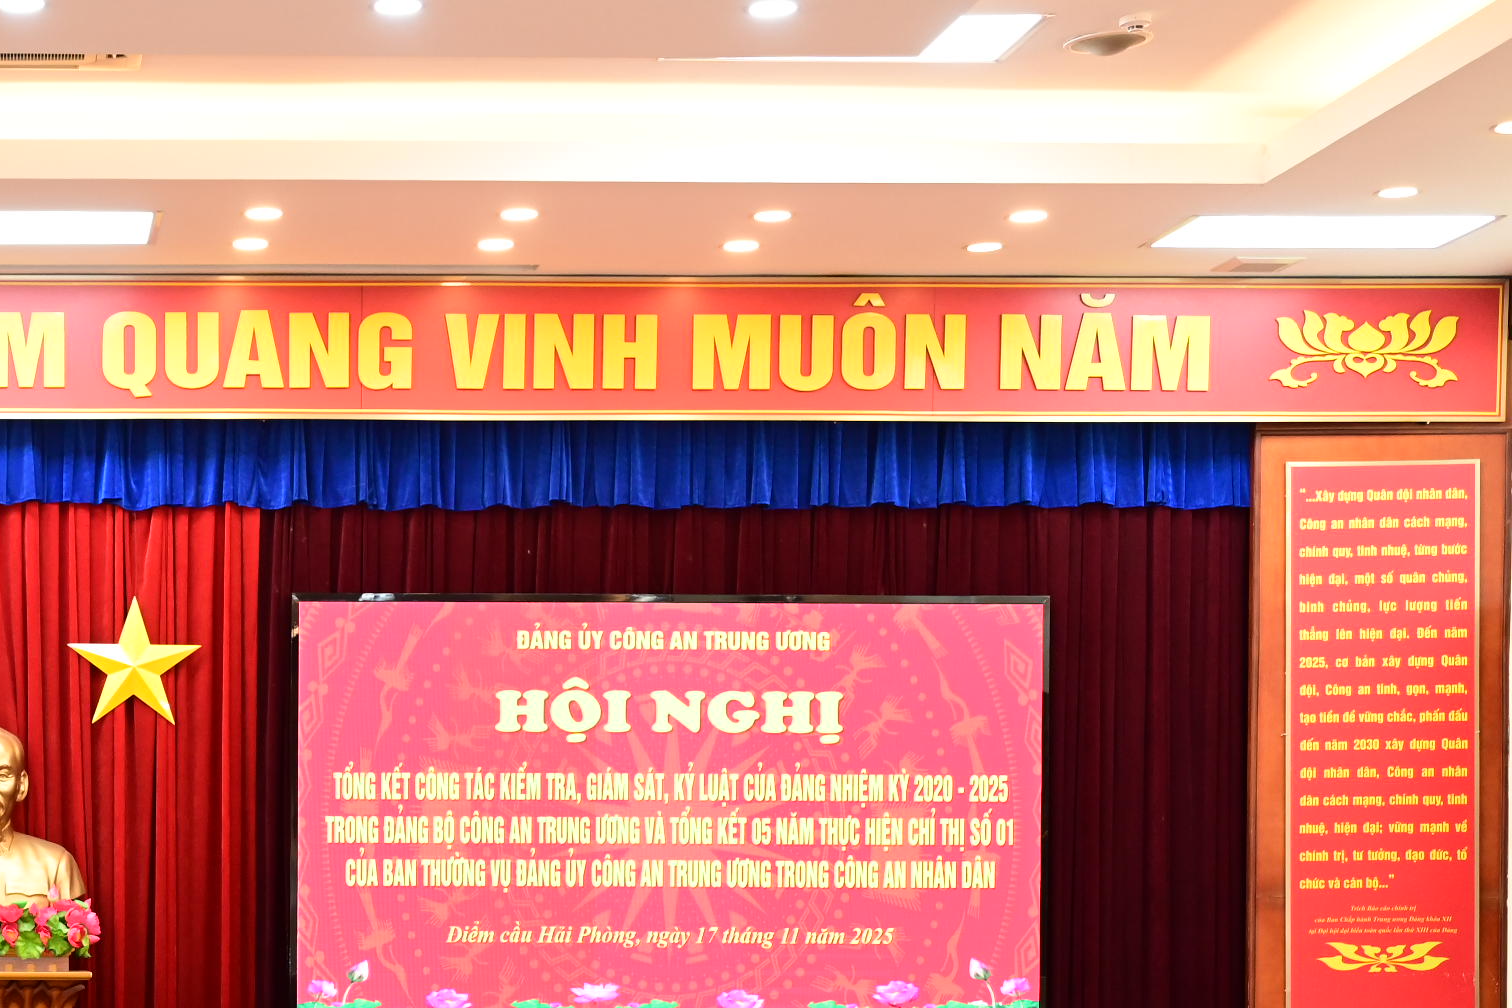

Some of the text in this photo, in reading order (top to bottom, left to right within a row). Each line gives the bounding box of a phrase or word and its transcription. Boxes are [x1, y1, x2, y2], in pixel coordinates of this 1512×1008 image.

[99, 307, 414, 397] QUANG
[445, 311, 659, 390] VINH
[690, 291, 968, 392] MUÔN
[998, 291, 1212, 392] NĂM
[517, 623, 830, 651] ĐẢNG ỦY CÔNG AN TRUNG ƯƠNG
[495, 677, 843, 744] HỘI NGHỊ
[1354, 739, 1379, 750] 2030
[1442, 738, 1468, 750] Quân
[333, 761, 376, 800] TỔNG
[381, 763, 410, 800] KẾT
[415, 767, 459, 800] CÔNG
[464, 767, 494, 800] TÁC
[500, 762, 541, 800] KIỂM
[546, 773, 581, 803] TRA,
[587, 767, 628, 800] GIÁM
[634, 767, 669, 804] SÁT,
[674, 762, 695, 801] KỶ
[699, 768, 739, 807] LUẬT
[744, 762, 776, 801] CỦA
[781, 762, 825, 801] ĐẢNG
[830, 769, 883, 807] NHIỆM
[888, 768, 909, 801] KỲ
[914, 775, 952, 802] 2020
[969, 775, 1008, 802] 2025
[325, 804, 1013, 851] TRONG ĐẢNG BỘ CÔNG AN TRUNG ƯƠNG VÀ TỔNG KẾT 05 NĂM THỰC HIỆN CHỈ THỊ SỐ 01
[346, 848, 995, 892] CỦA BAN THƯỜNG VỤ ĐẢNG ỦY CÔNG AN TRUNG ƯƠNG TRONG CÔNG AN NHÂN DÂN
[447, 921, 894, 948] Điểm cầu Hải Phòng, ngày 17 tháng 11 năm 2025
